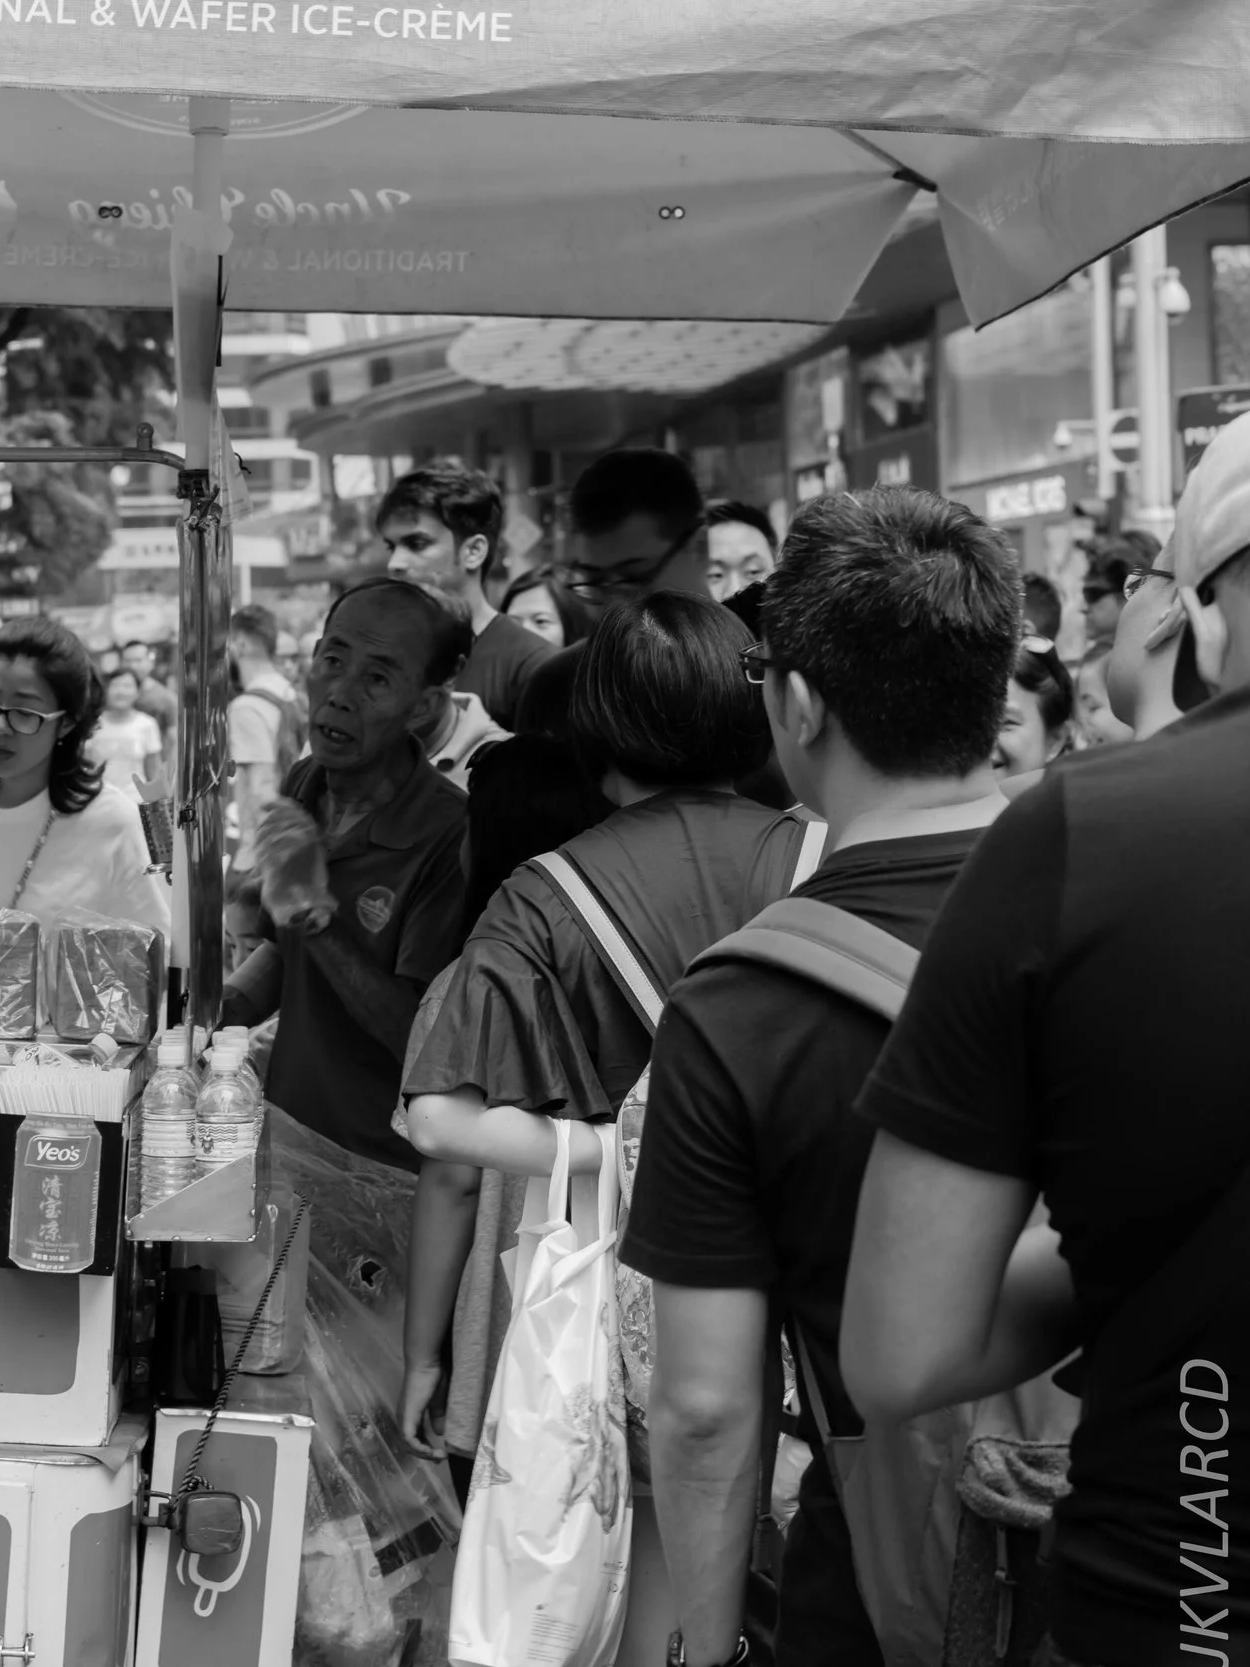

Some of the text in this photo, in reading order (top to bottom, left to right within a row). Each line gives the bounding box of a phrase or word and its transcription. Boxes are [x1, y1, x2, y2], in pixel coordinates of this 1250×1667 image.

[90, 0, 116, 26] &
[130, 0, 277, 33] WAFER
[291, 3, 513, 42] ICE-CRÈME
[36, 1141, 81, 1162] Yeo's
